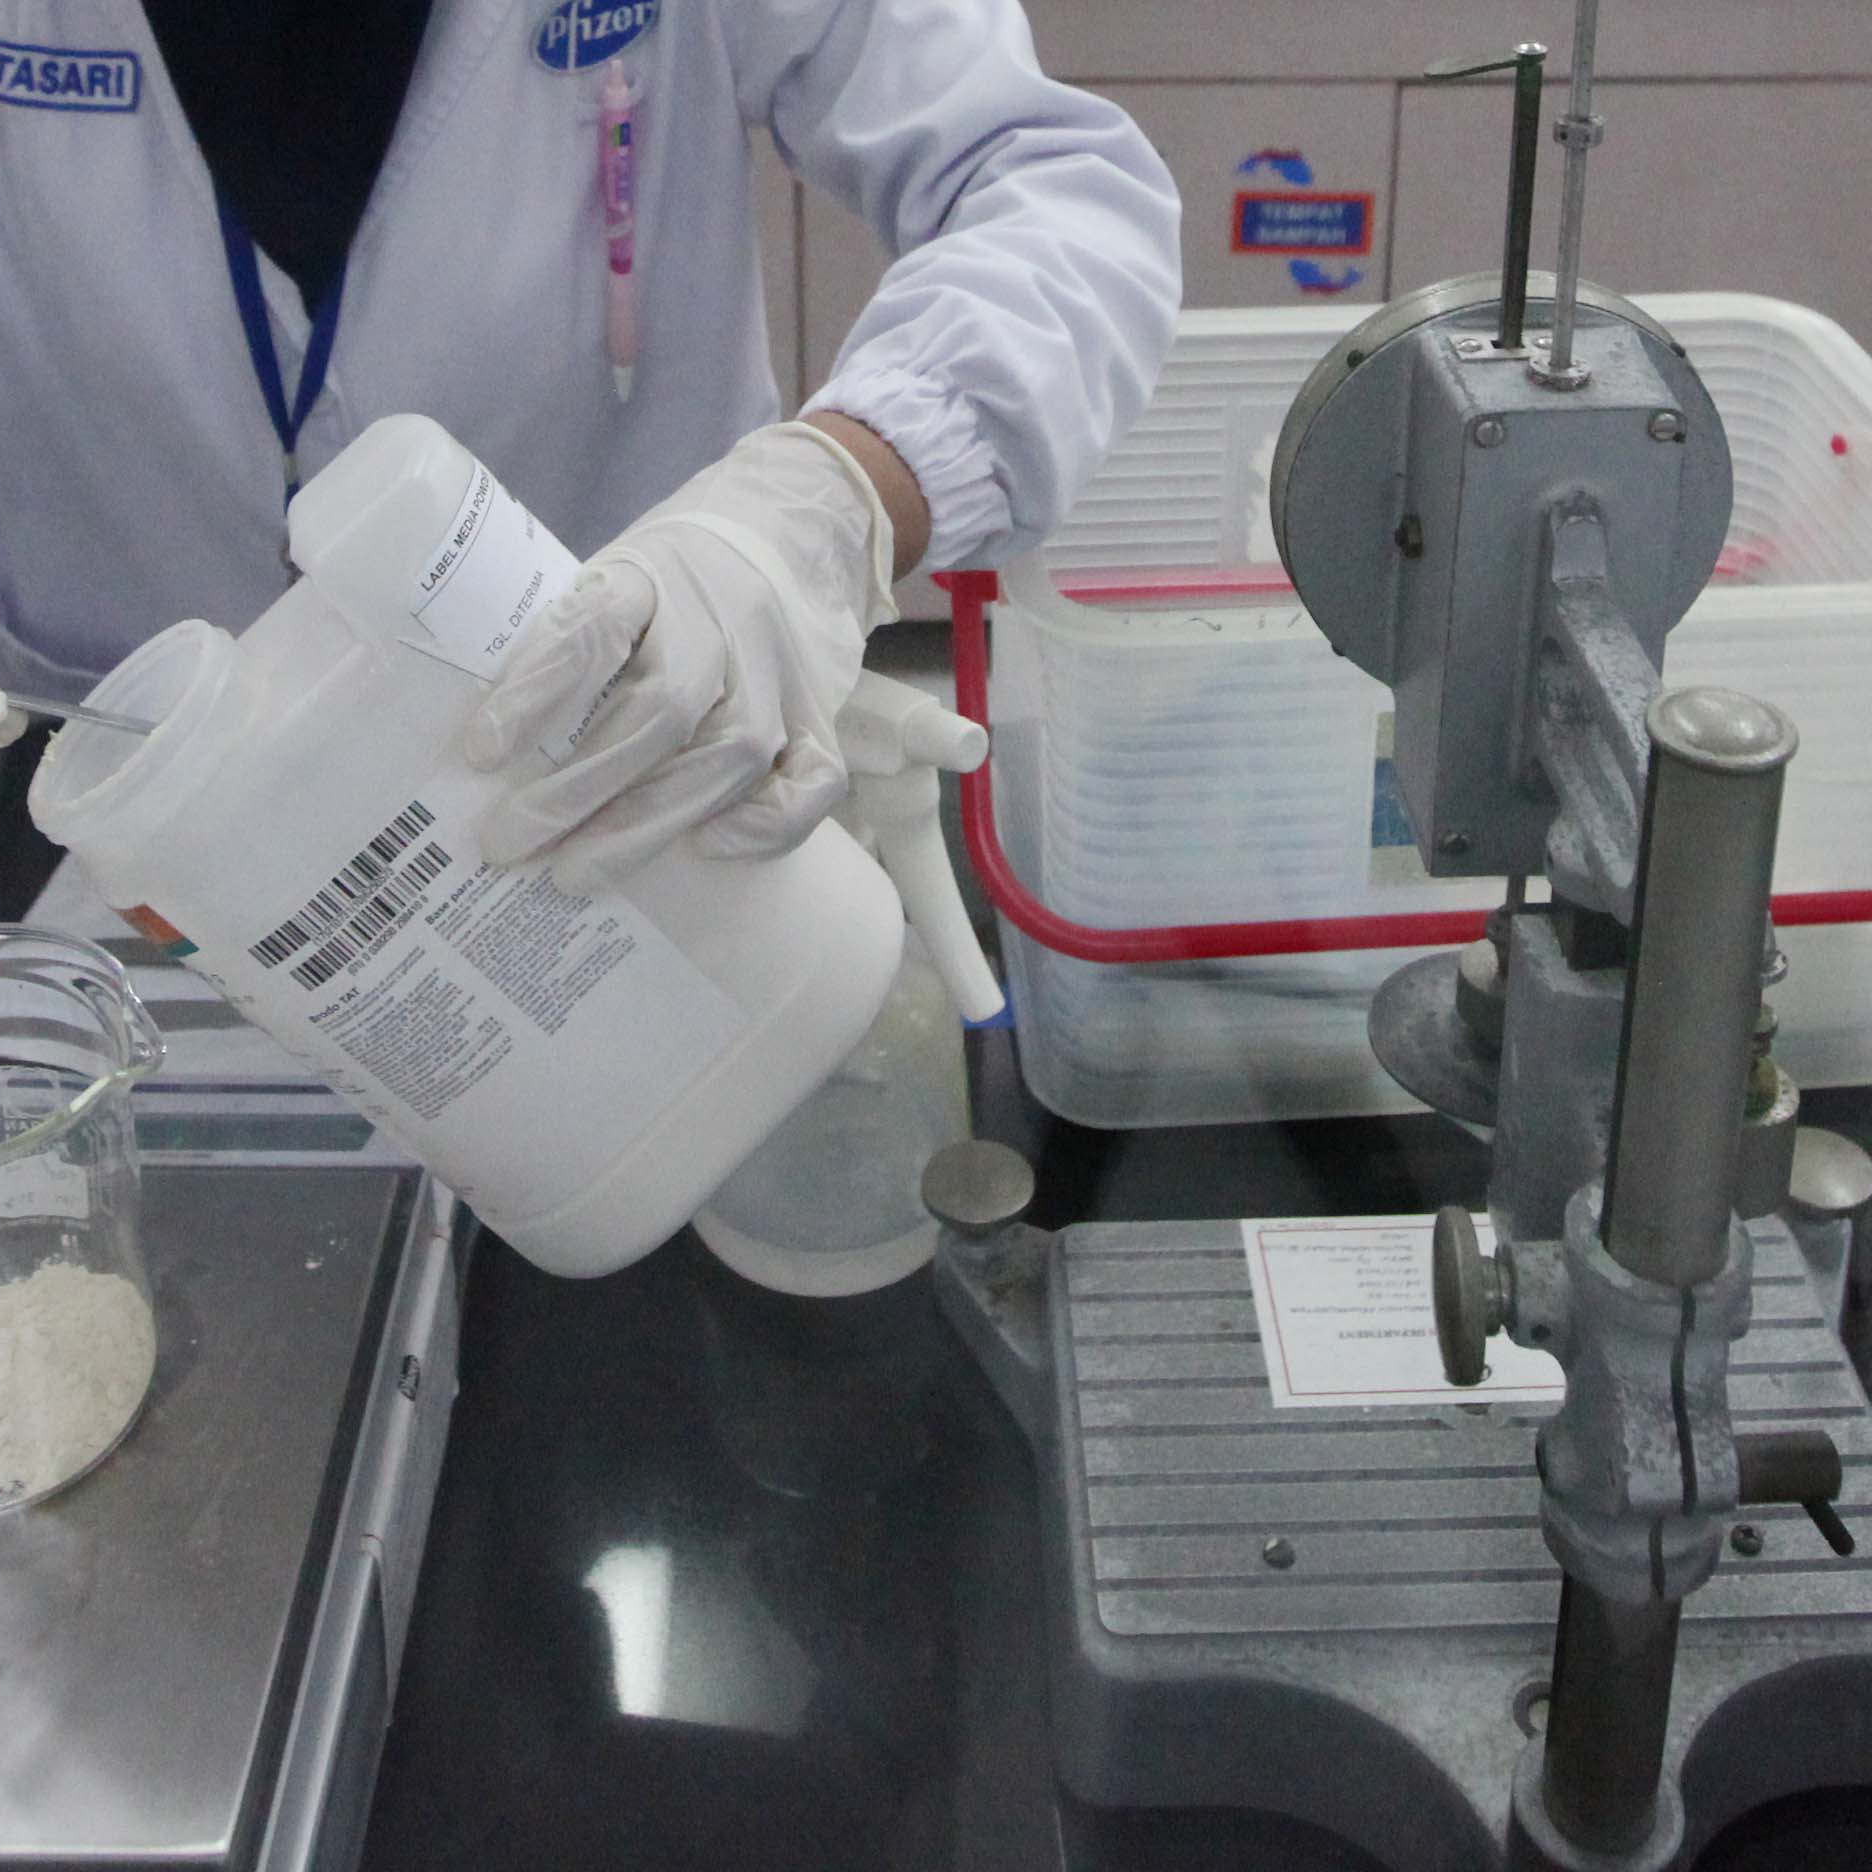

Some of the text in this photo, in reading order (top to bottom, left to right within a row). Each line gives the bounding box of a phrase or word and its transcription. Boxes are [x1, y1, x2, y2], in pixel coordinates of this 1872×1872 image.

[420, 550, 458, 592] LABEL
[453, 509, 480, 548] MEDIA
[509, 569, 544, 629] DITERIMA
[425, 901, 451, 926] Base
[450, 879, 475, 903] para
[308, 986, 361, 1024] Brodo TAT
